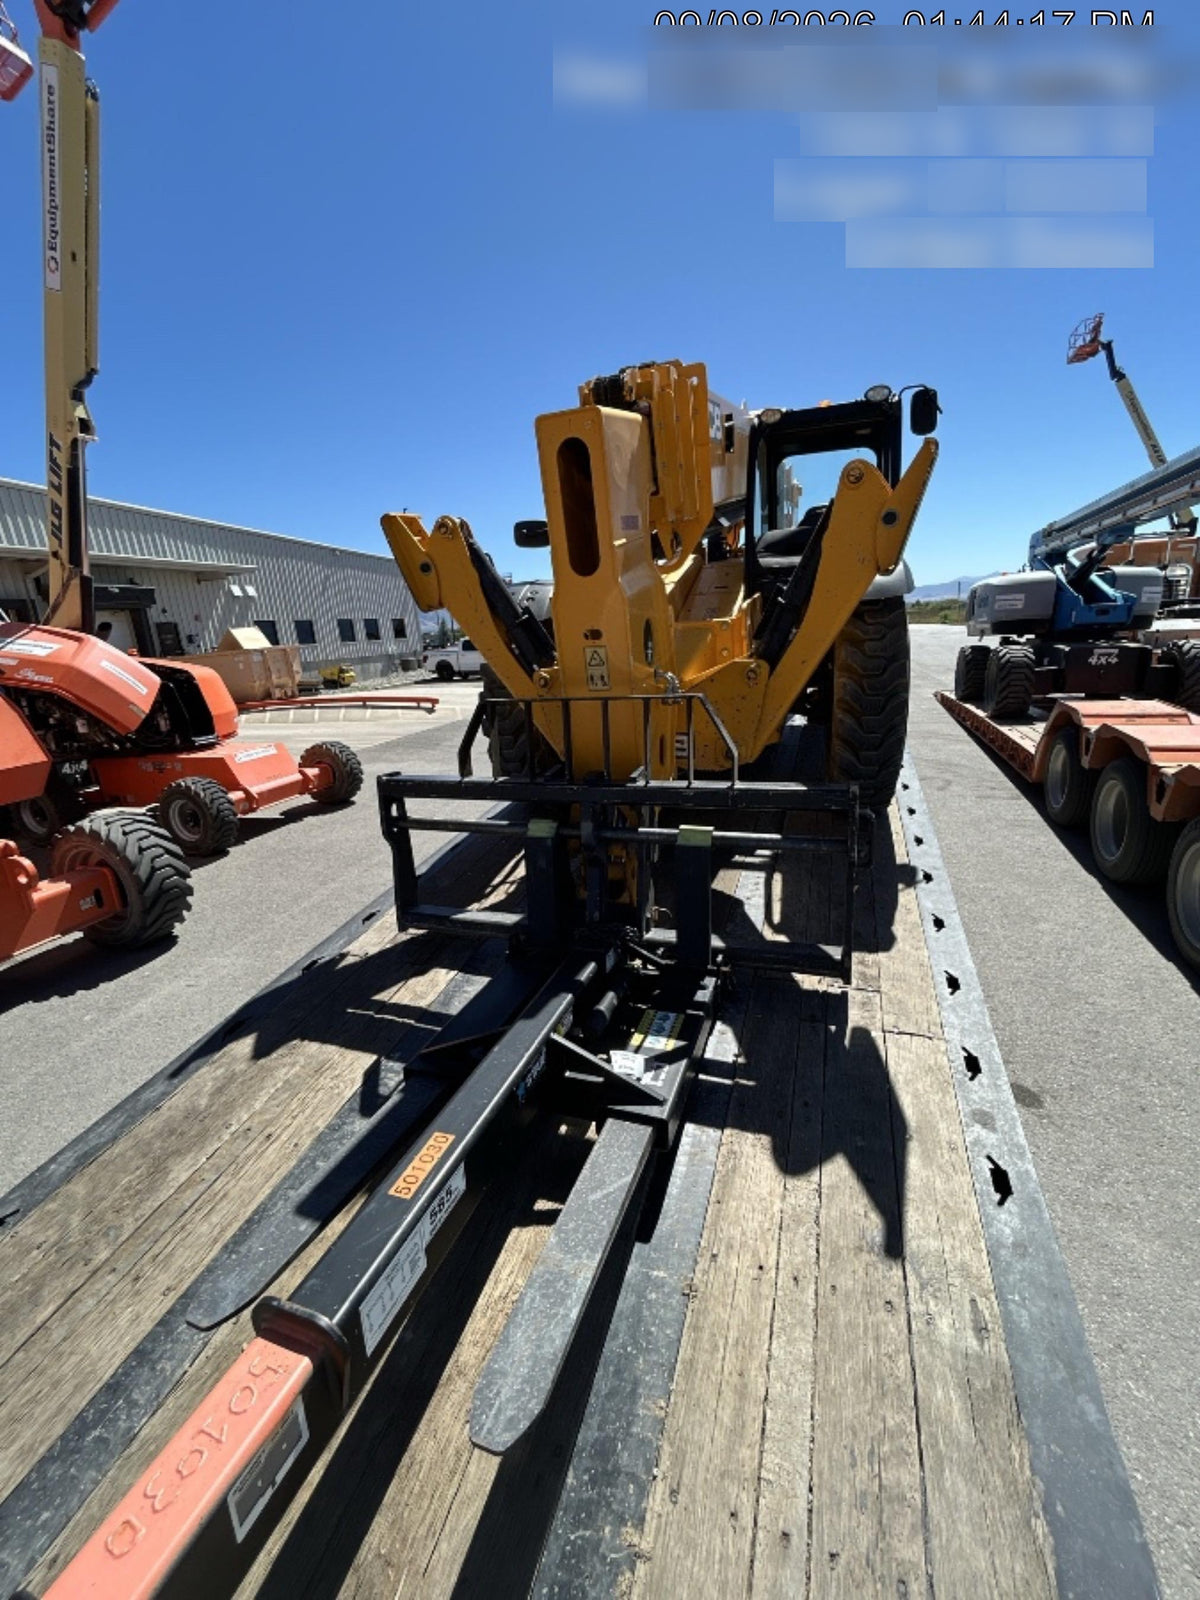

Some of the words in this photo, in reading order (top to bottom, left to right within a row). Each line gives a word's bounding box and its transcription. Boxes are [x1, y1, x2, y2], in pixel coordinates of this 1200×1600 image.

[46, 84, 59, 253] EquipmentShare
[49, 431, 63, 497] LIFT
[50, 498, 63, 550] JLG
[394, 1135, 449, 1196] 501030
[103, 1356, 285, 1560] 501030
